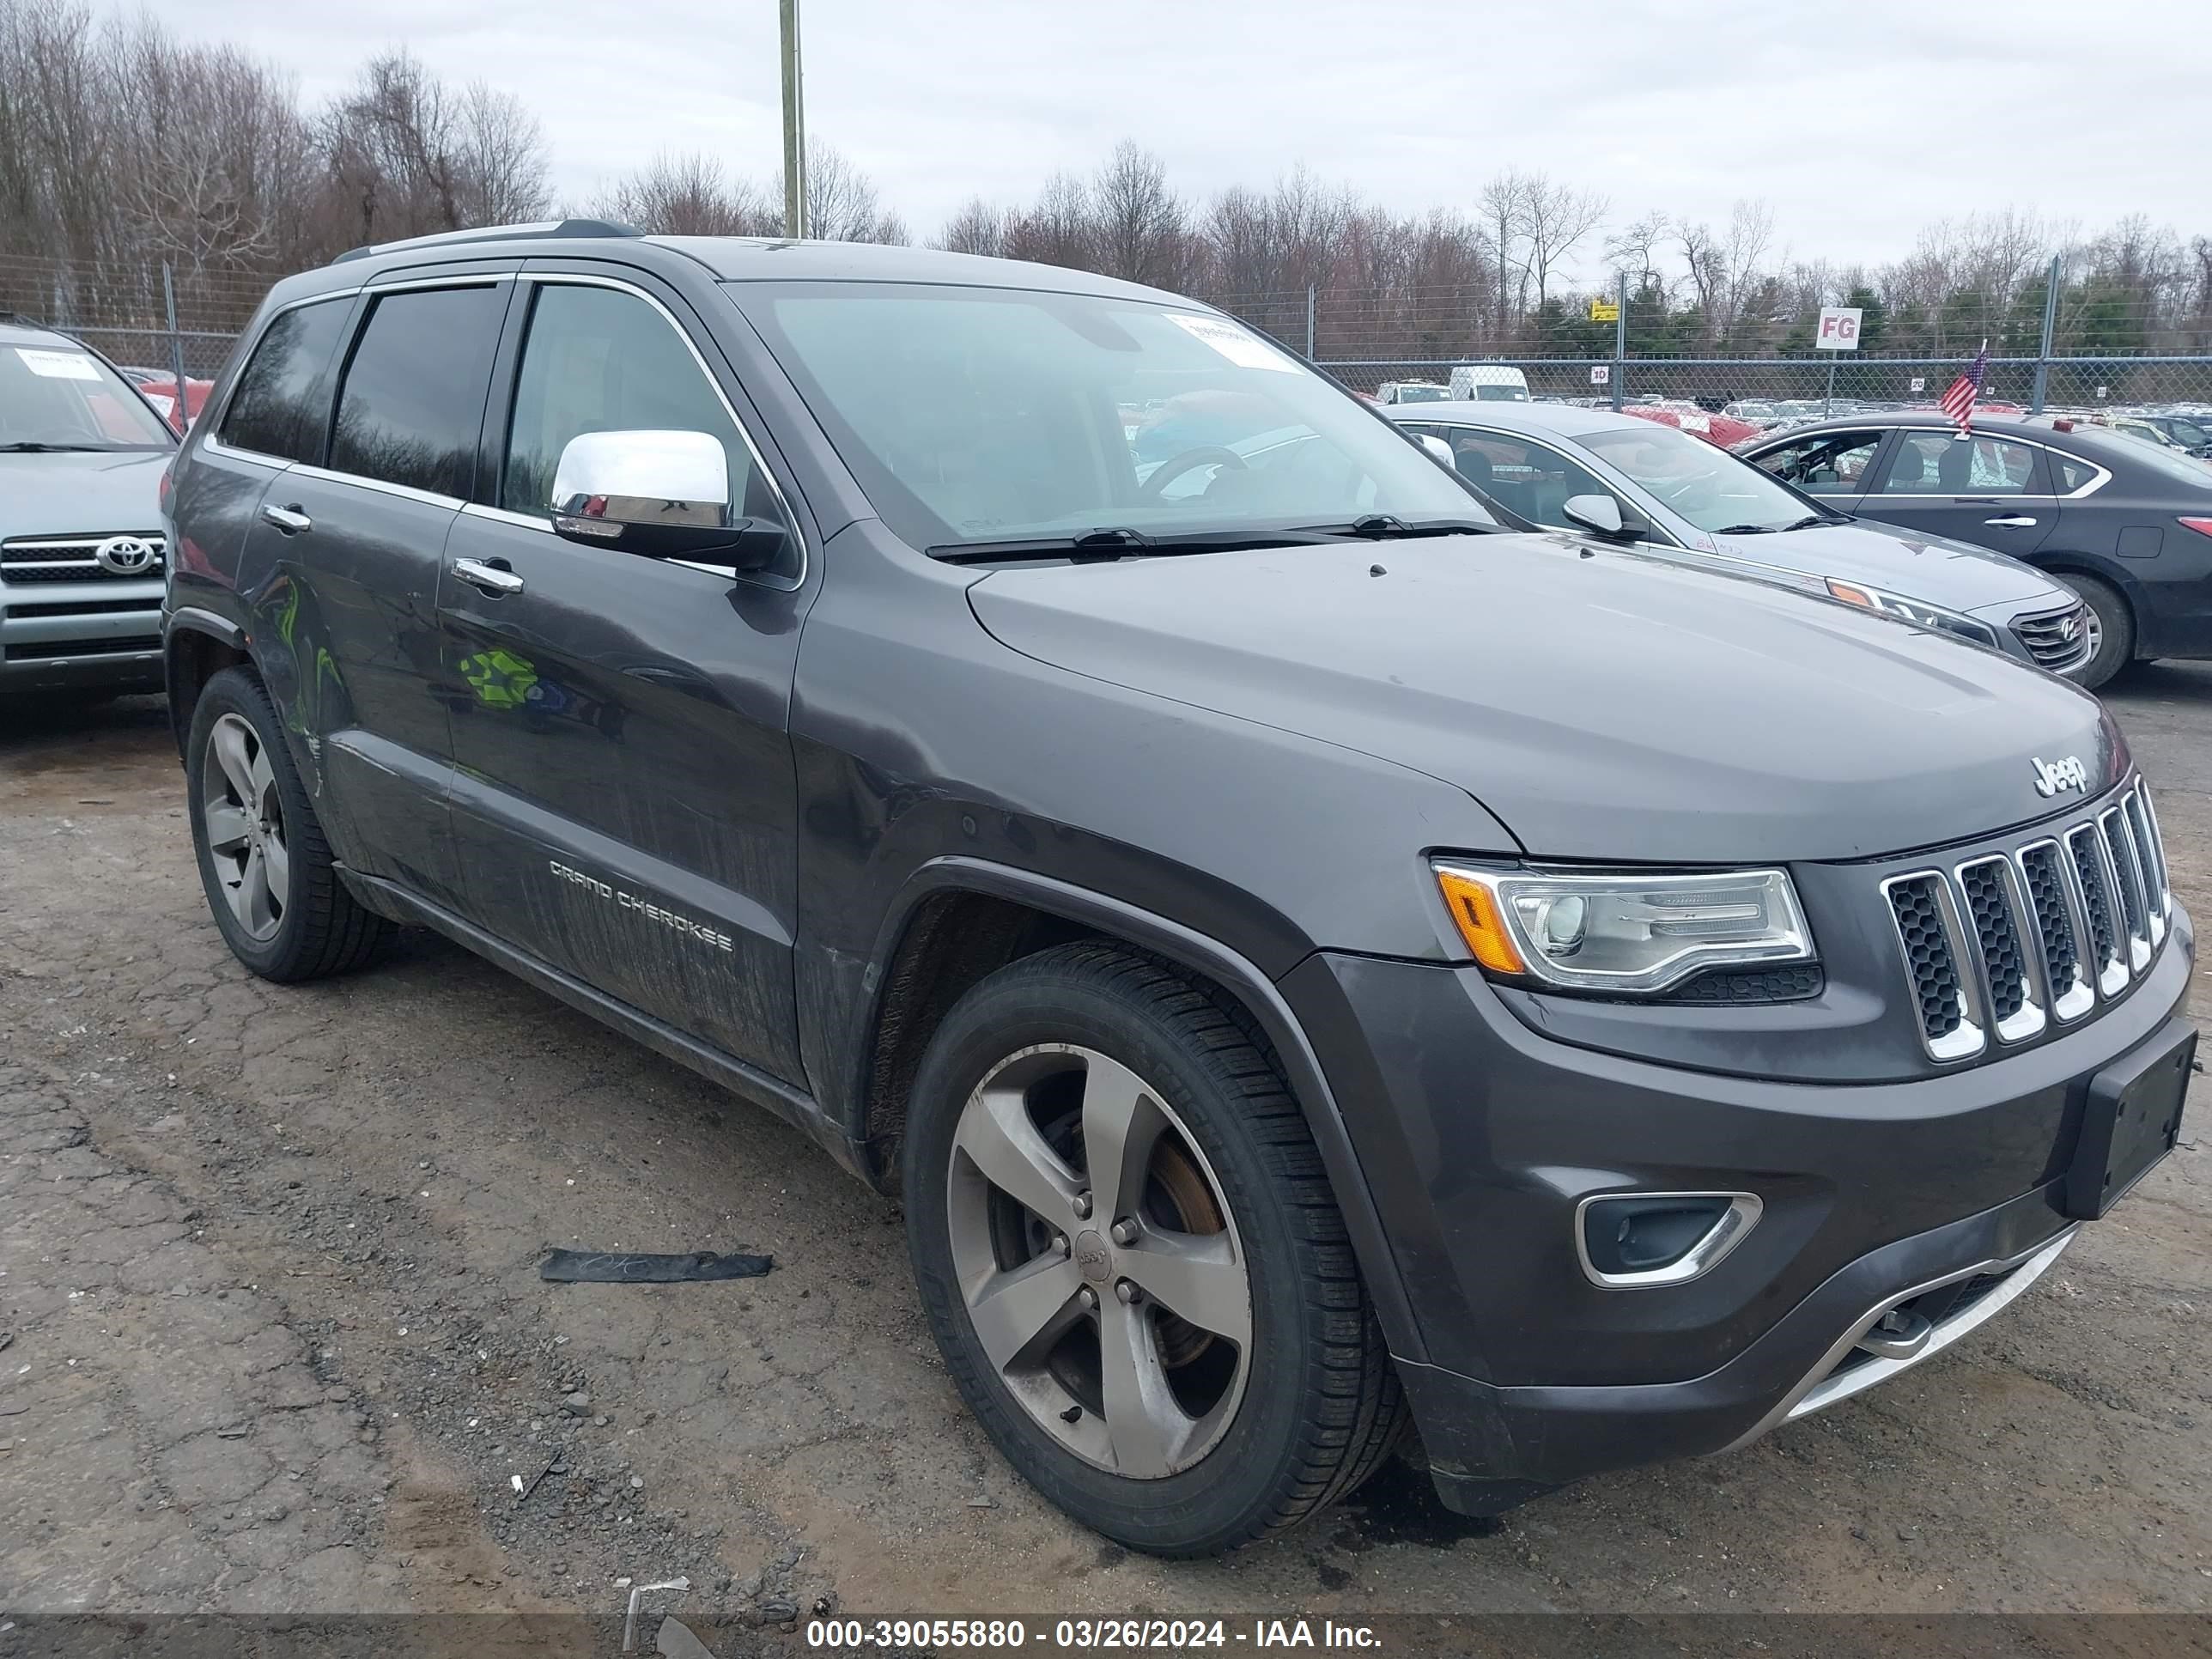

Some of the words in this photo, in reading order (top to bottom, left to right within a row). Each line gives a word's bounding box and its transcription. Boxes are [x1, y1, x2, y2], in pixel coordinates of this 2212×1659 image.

[1823, 317, 1856, 338] FG
[2030, 756, 2086, 797] Jeep
[550, 860, 612, 899] GRAND
[617, 891, 733, 952] CHEROKEE
